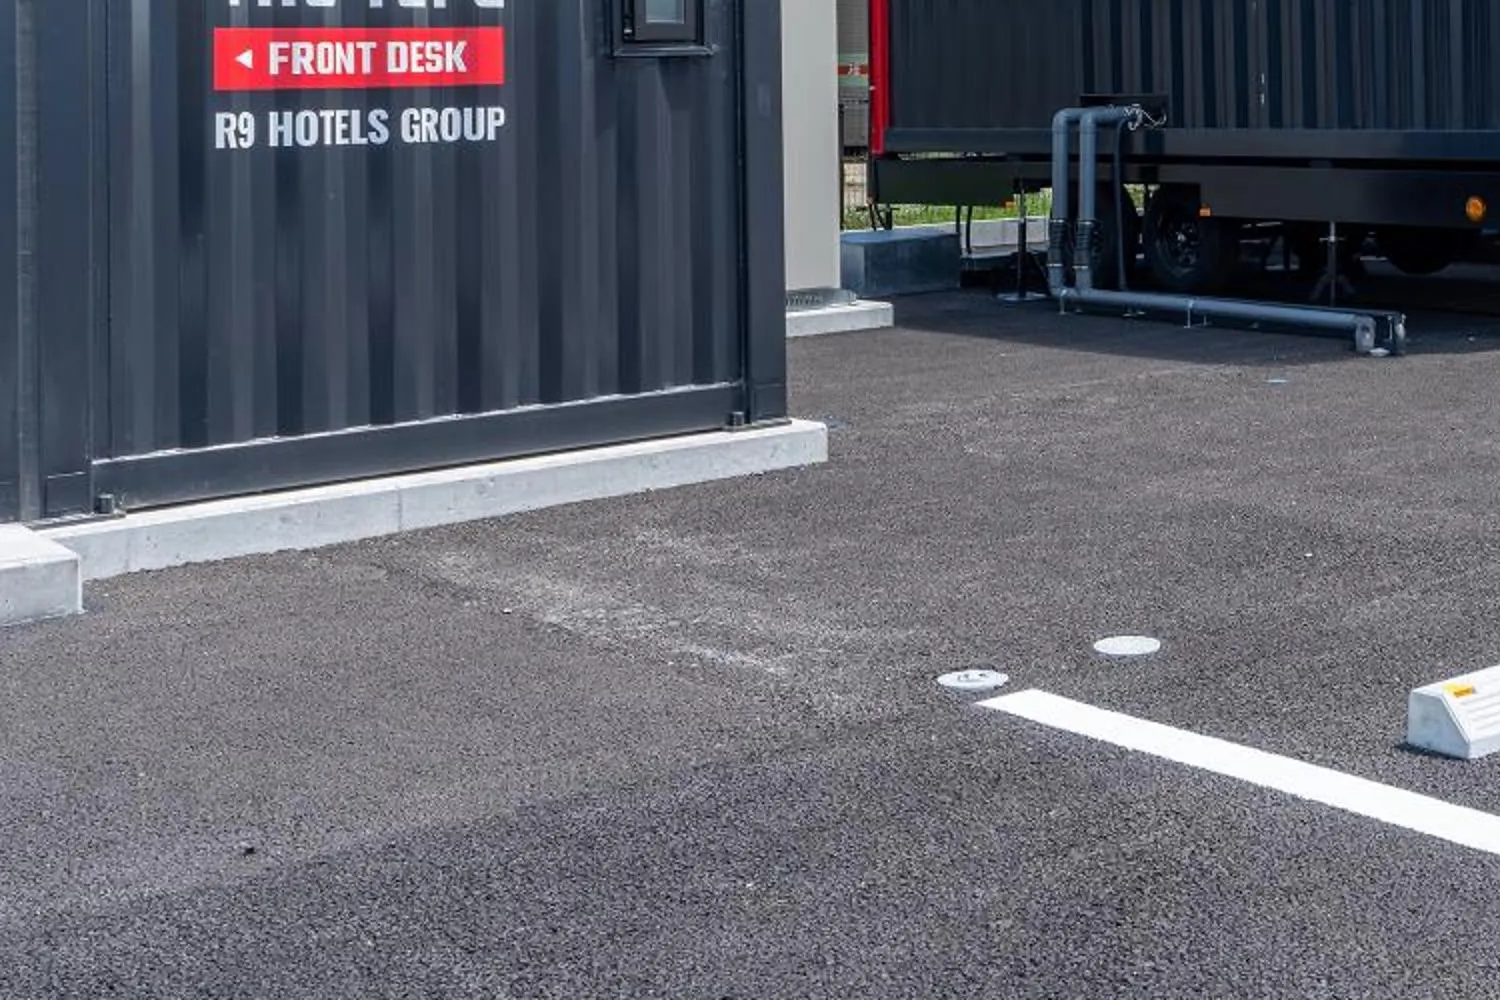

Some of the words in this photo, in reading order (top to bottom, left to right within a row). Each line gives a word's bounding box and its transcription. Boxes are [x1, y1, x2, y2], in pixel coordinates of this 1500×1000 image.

[268, 42, 376, 75] FRONT
[387, 40, 467, 74] DESK
[215, 111, 255, 149] R9
[269, 109, 389, 147] HOTELS
[401, 107, 505, 143] GROUP
